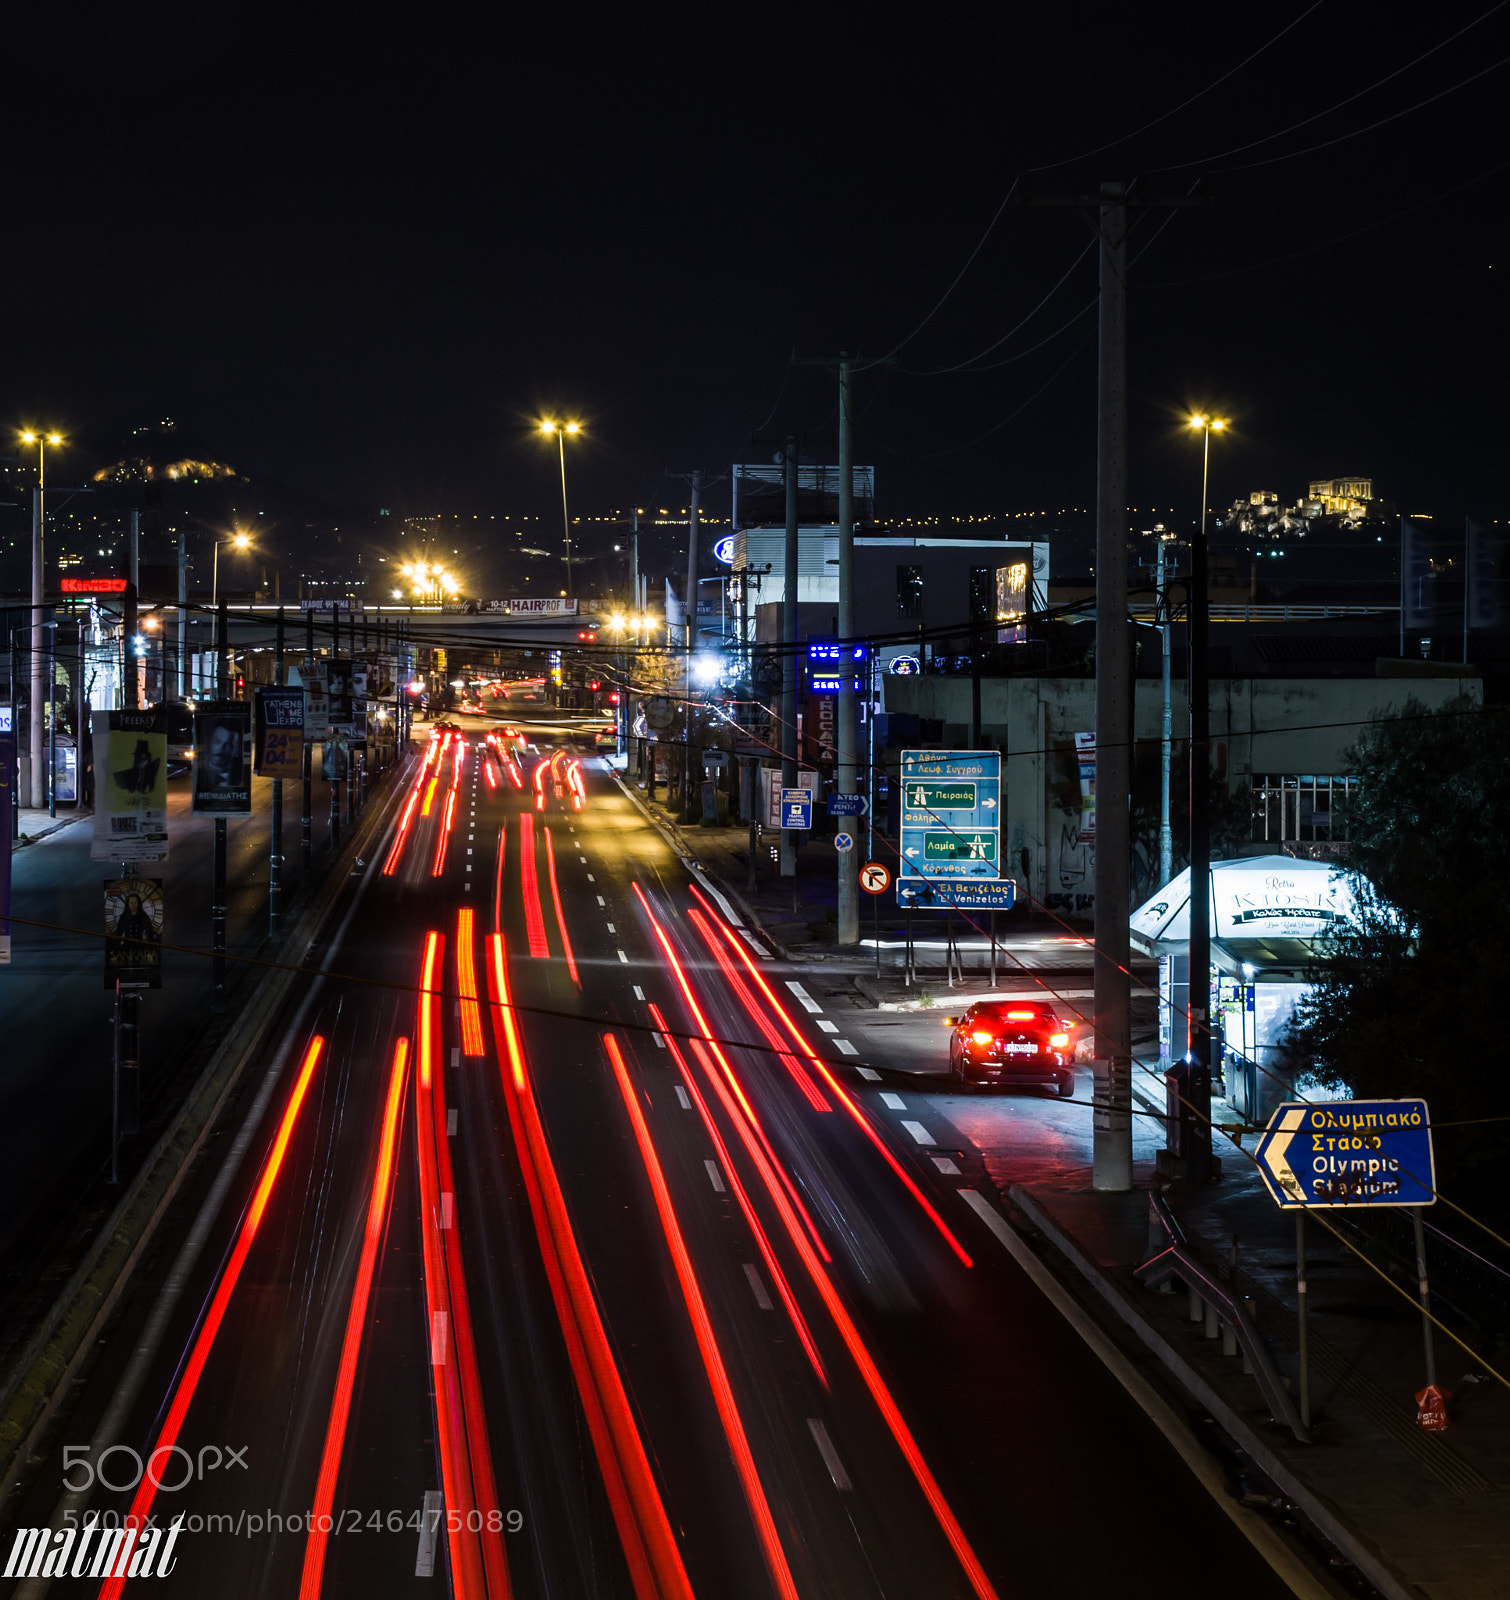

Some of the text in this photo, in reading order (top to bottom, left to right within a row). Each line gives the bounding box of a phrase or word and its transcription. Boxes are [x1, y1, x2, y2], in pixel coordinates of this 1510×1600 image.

[269, 700, 303, 709] ATHENS
[279, 717, 303, 726] EXPO
[267, 733, 288, 748] 24
[265, 749, 286, 765] 04
[917, 764, 983, 776] Λεωφ. Συγγρού
[936, 791, 973, 801] Πειραιάς
[904, 814, 940, 824] Φάληρο
[927, 841, 955, 852] Λαμία
[922, 863, 967, 875] Κόρινθος
[1265, 876, 1295, 891] Retro
[1311, 1107, 1421, 1131] Ολυμπιακό
[1312, 1156, 1399, 1177] Olympic
[1312, 1177, 1399, 1196] Stadium
